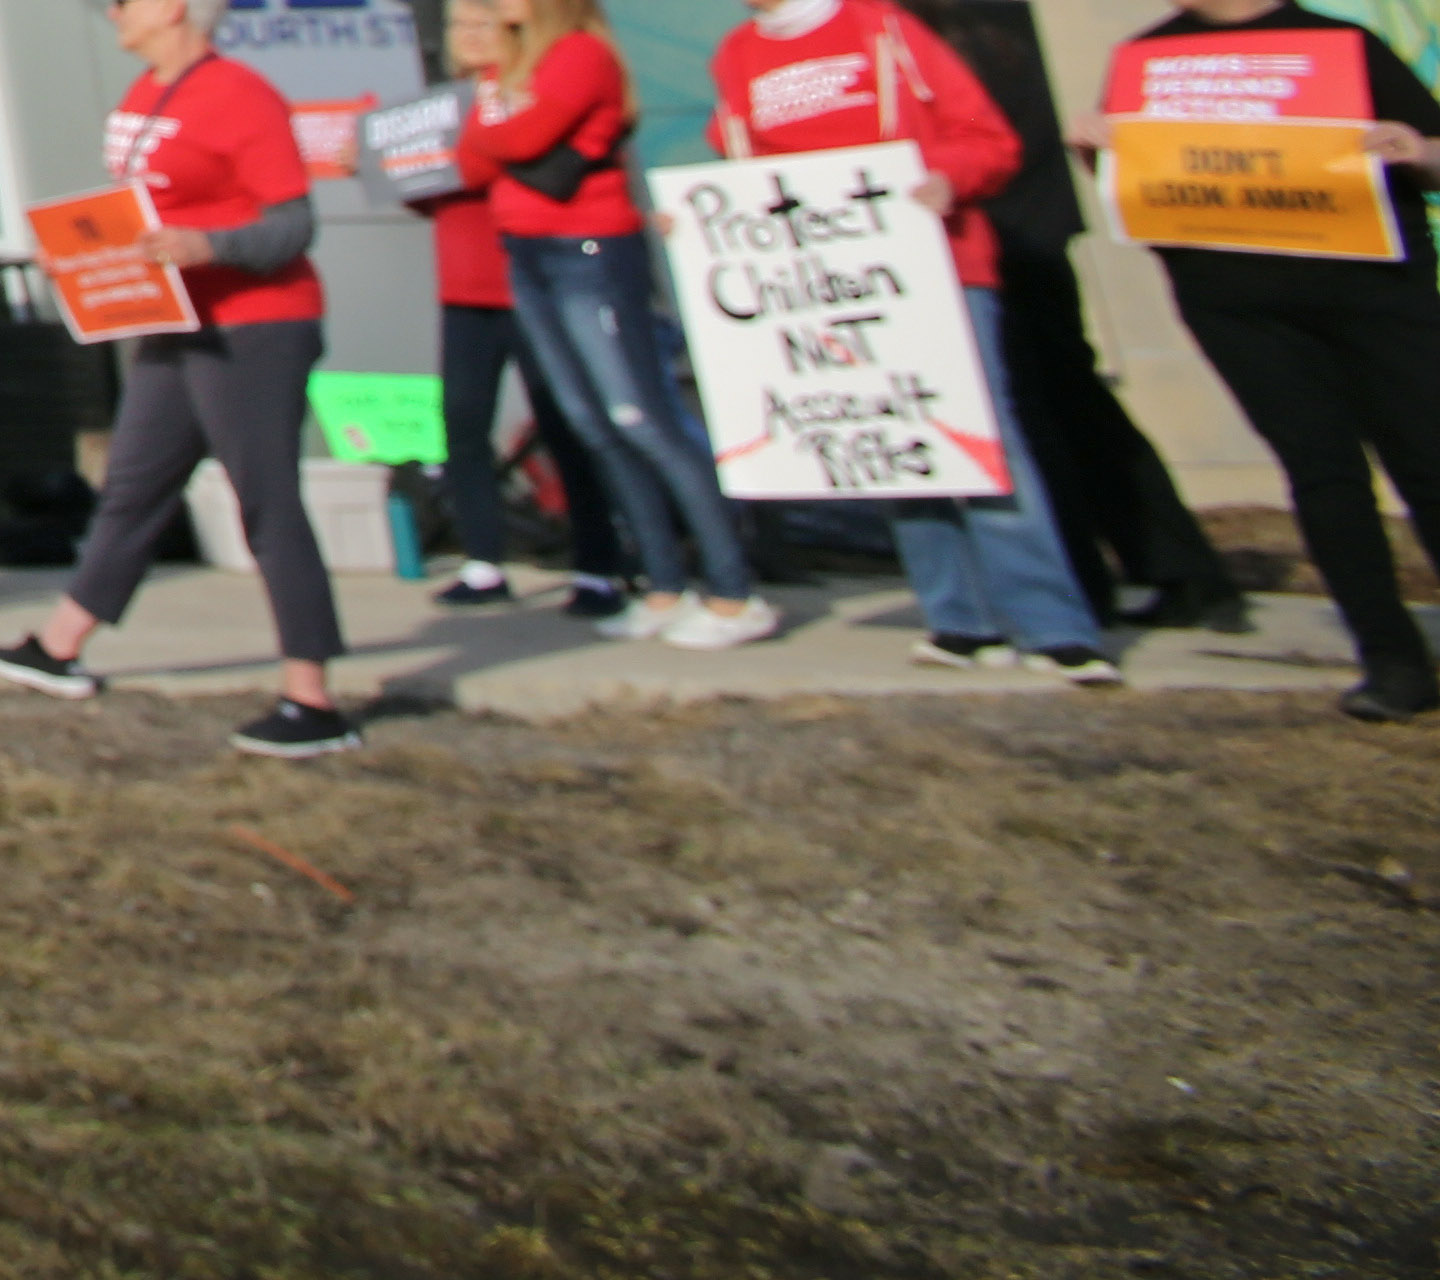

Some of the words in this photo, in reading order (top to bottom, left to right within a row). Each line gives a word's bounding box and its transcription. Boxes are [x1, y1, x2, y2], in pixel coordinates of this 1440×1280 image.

[213, 13, 365, 49] OURTH
[686, 169, 890, 254] Protect
[707, 254, 903, 320] Children
